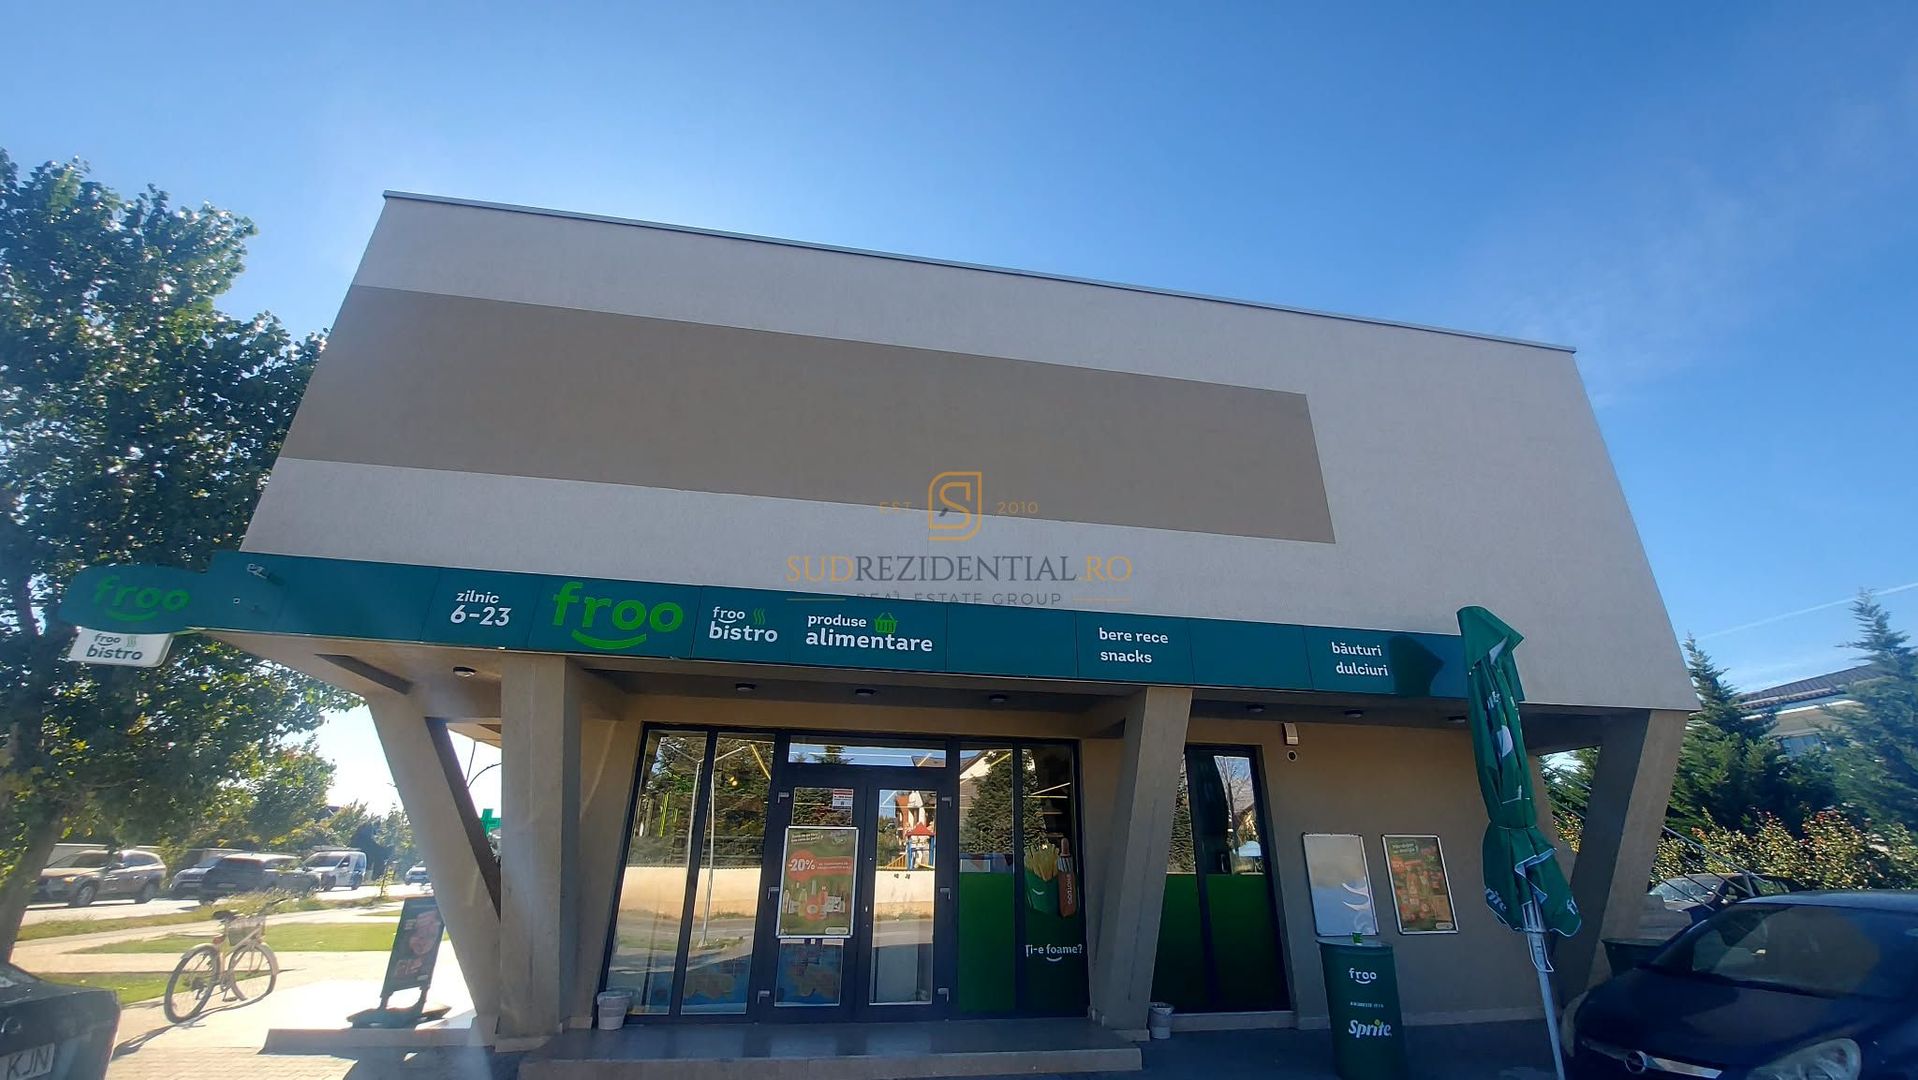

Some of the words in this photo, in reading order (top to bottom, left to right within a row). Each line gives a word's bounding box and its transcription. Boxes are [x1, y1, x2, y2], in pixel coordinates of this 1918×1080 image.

[94, 575, 192, 614] froo
[456, 589, 500, 605] zilnic
[552, 581, 685, 633] froo
[711, 606, 746, 623] froo
[450, 605, 512, 627] 6-23
[807, 614, 867, 631] produse
[94, 633, 121, 645] froo
[709, 621, 778, 643] bistro
[1099, 627, 1132, 642] bere
[1135, 632, 1169, 645] rece
[805, 629, 933, 653] alimentare
[1331, 641, 1383, 657] băuturi
[86, 645, 143, 660] bistro
[1100, 648, 1153, 664] snacks
[1336, 661, 1389, 677] dulciuri
[788, 858, 816, 872] -20%
[1046, 943, 1083, 955] foame?
[1348, 967, 1377, 980] froo
[1348, 1018, 1392, 1039] Sprite
